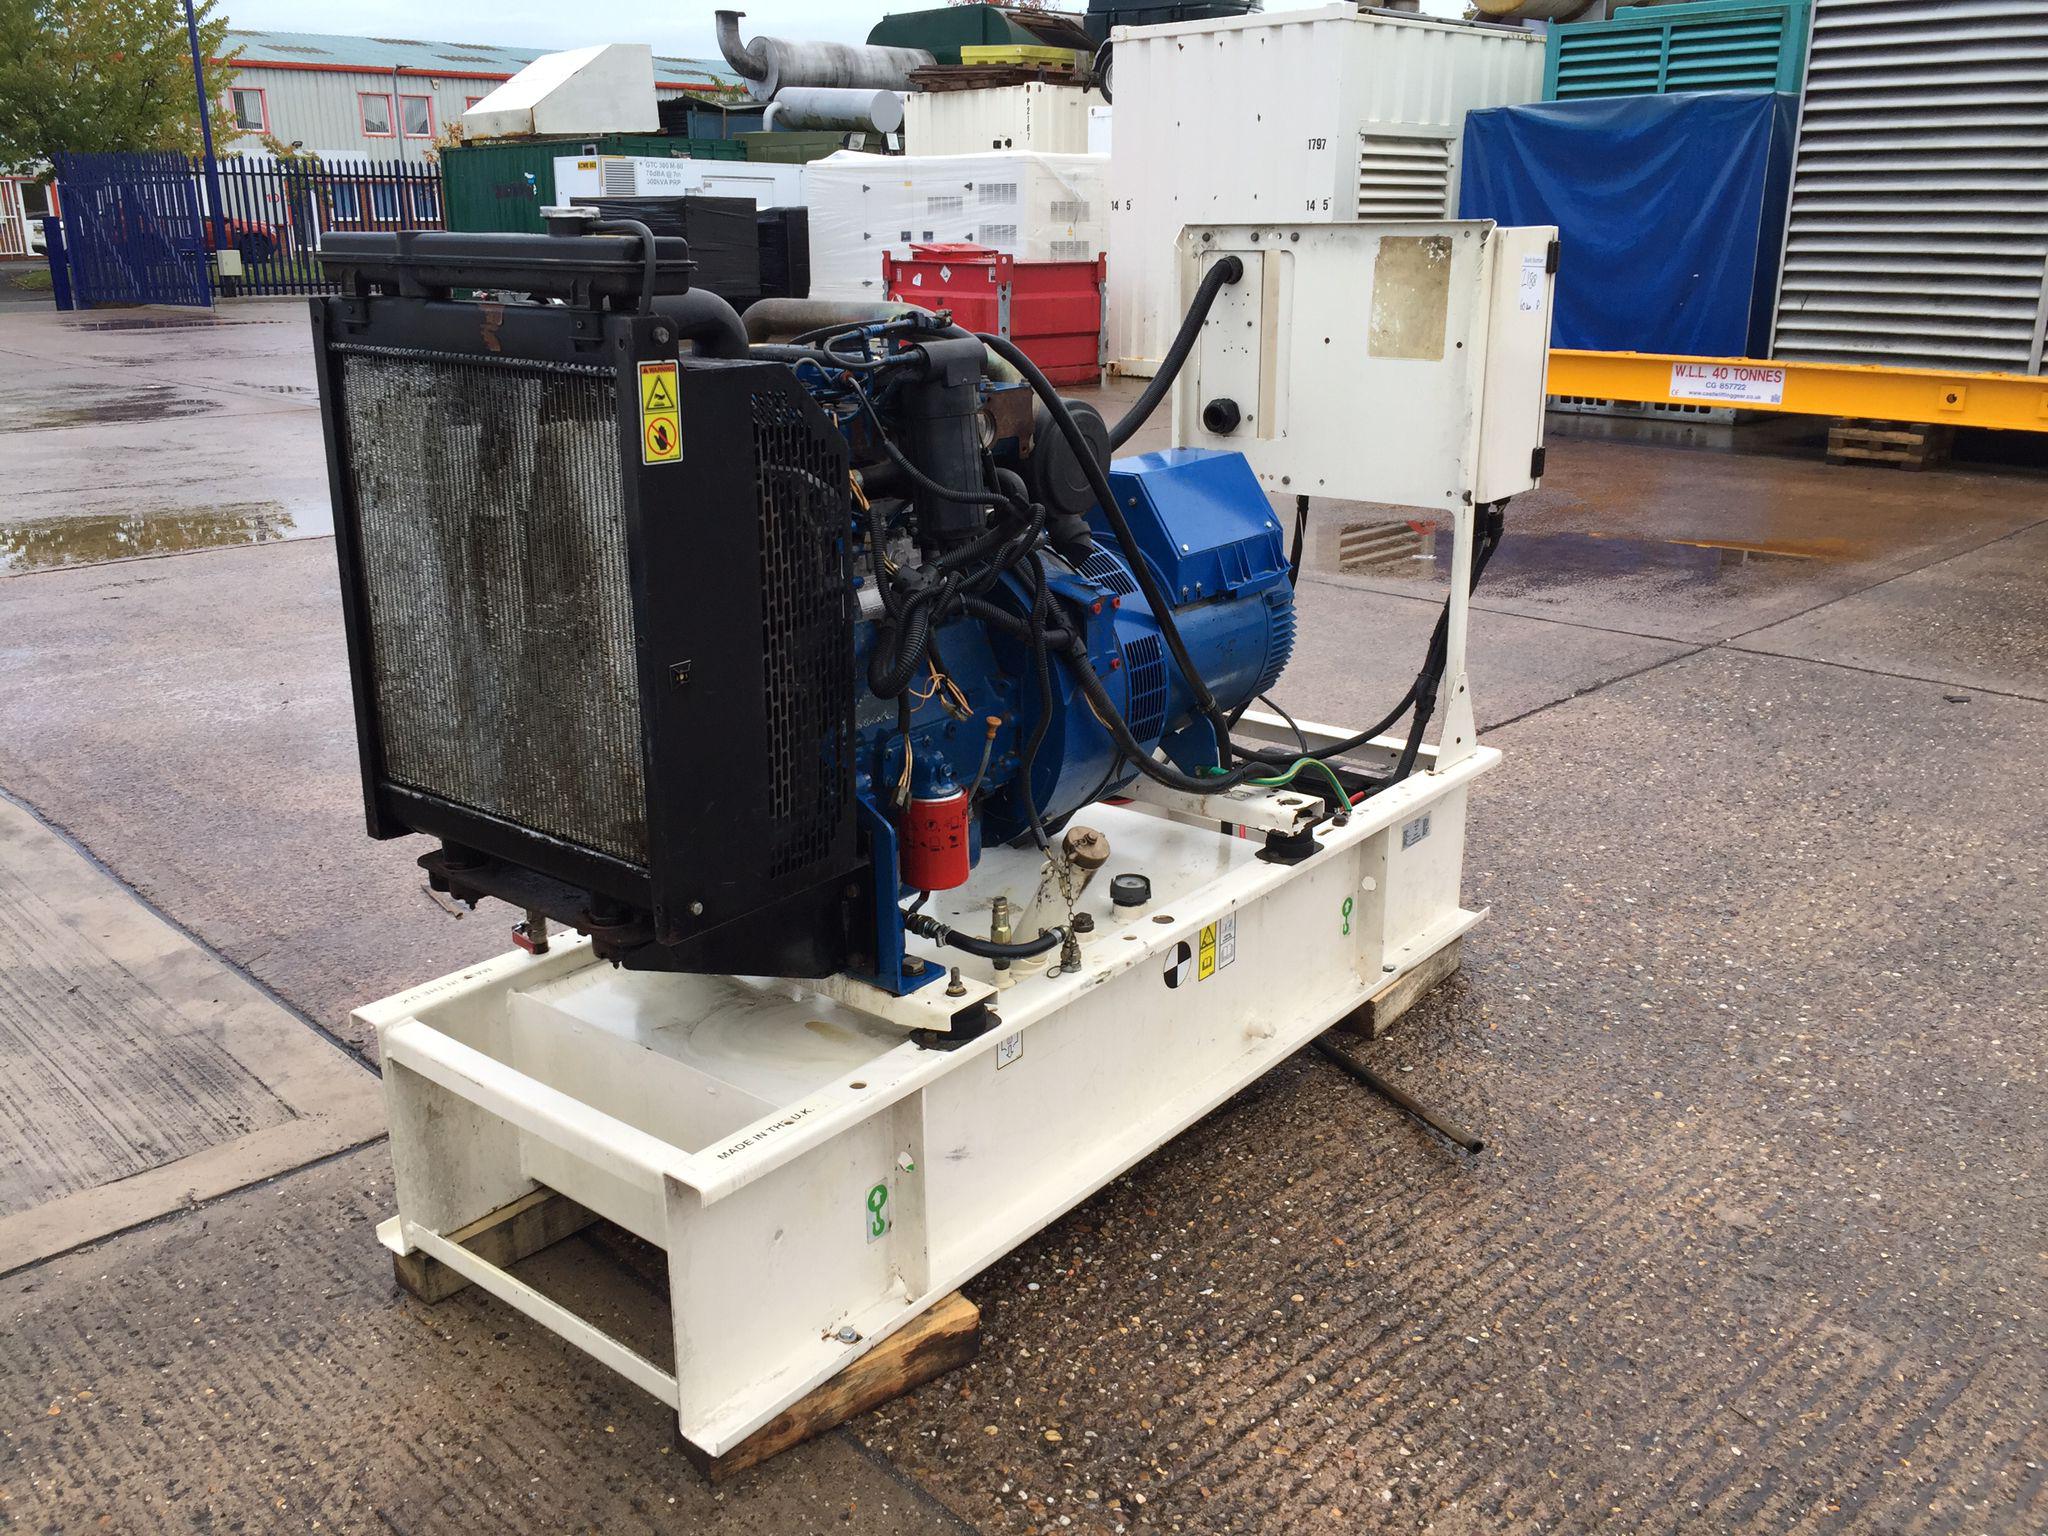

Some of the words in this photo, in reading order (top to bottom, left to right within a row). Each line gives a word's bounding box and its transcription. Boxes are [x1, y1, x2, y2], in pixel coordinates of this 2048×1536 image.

[1308, 138, 1327, 150] 1797
[649, 366, 675, 374] WARNING
[1675, 365, 1707, 378] W.L.L.
[1712, 367, 1728, 380] 40
[1734, 368, 1783, 383] TONNES
[1705, 381, 1716, 389] CG
[1720, 383, 1747, 391] 857722
[717, 1138, 754, 1160] MADE
[753, 1131, 768, 1142] IN
